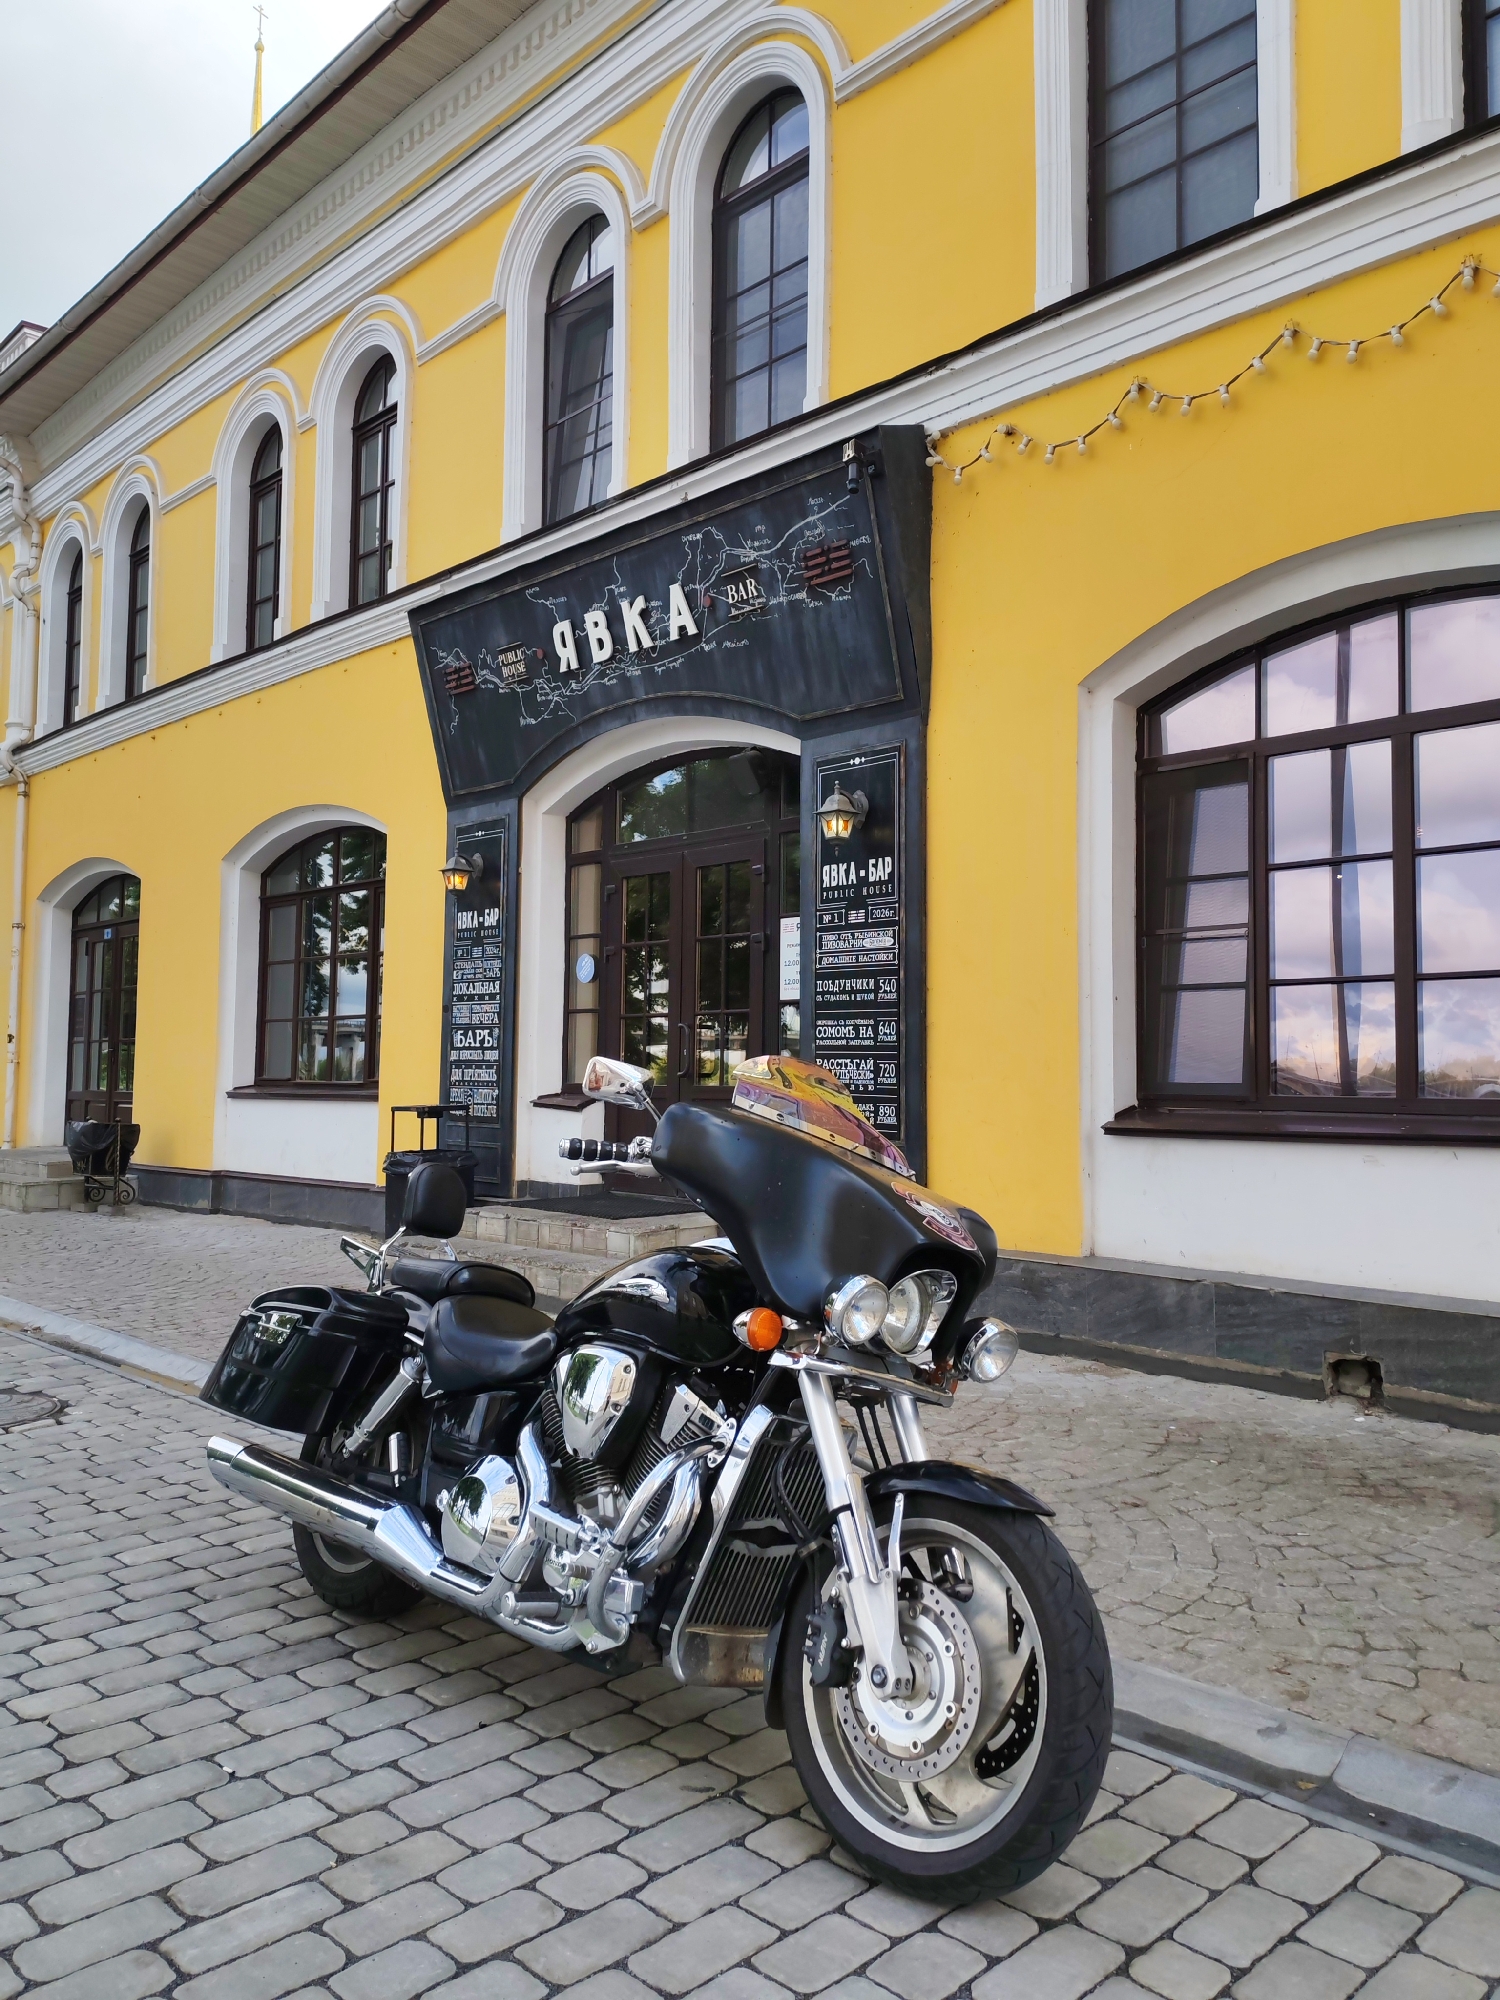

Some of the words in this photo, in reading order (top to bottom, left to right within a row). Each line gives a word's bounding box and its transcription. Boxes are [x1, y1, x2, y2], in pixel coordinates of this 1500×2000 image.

[726, 578, 759, 604] BAR
[552, 582, 699, 673] ЯВКА
[498, 647, 526, 666] PUBLIC
[502, 661, 526, 678] HOUSE
[823, 888, 855, 900] PUBLIC
[862, 884, 892, 896] HOUSE
[480, 928, 499, 936] HOUSE
[858, 952, 894, 962] НАСТОЙКИ
[453, 981, 500, 995] ЛОКАЛЬНАЯ
[878, 979, 896, 993] 540
[472, 1013, 499, 1024] ВЕЧЕРА
[816, 1026, 856, 1038] СОМОМЪ
[859, 1026, 874, 1038] НА
[878, 1022, 896, 1035] 640
[458, 1030, 492, 1047] БАРЪ
[879, 1064, 896, 1077] 720
[878, 1106, 896, 1116] 890
